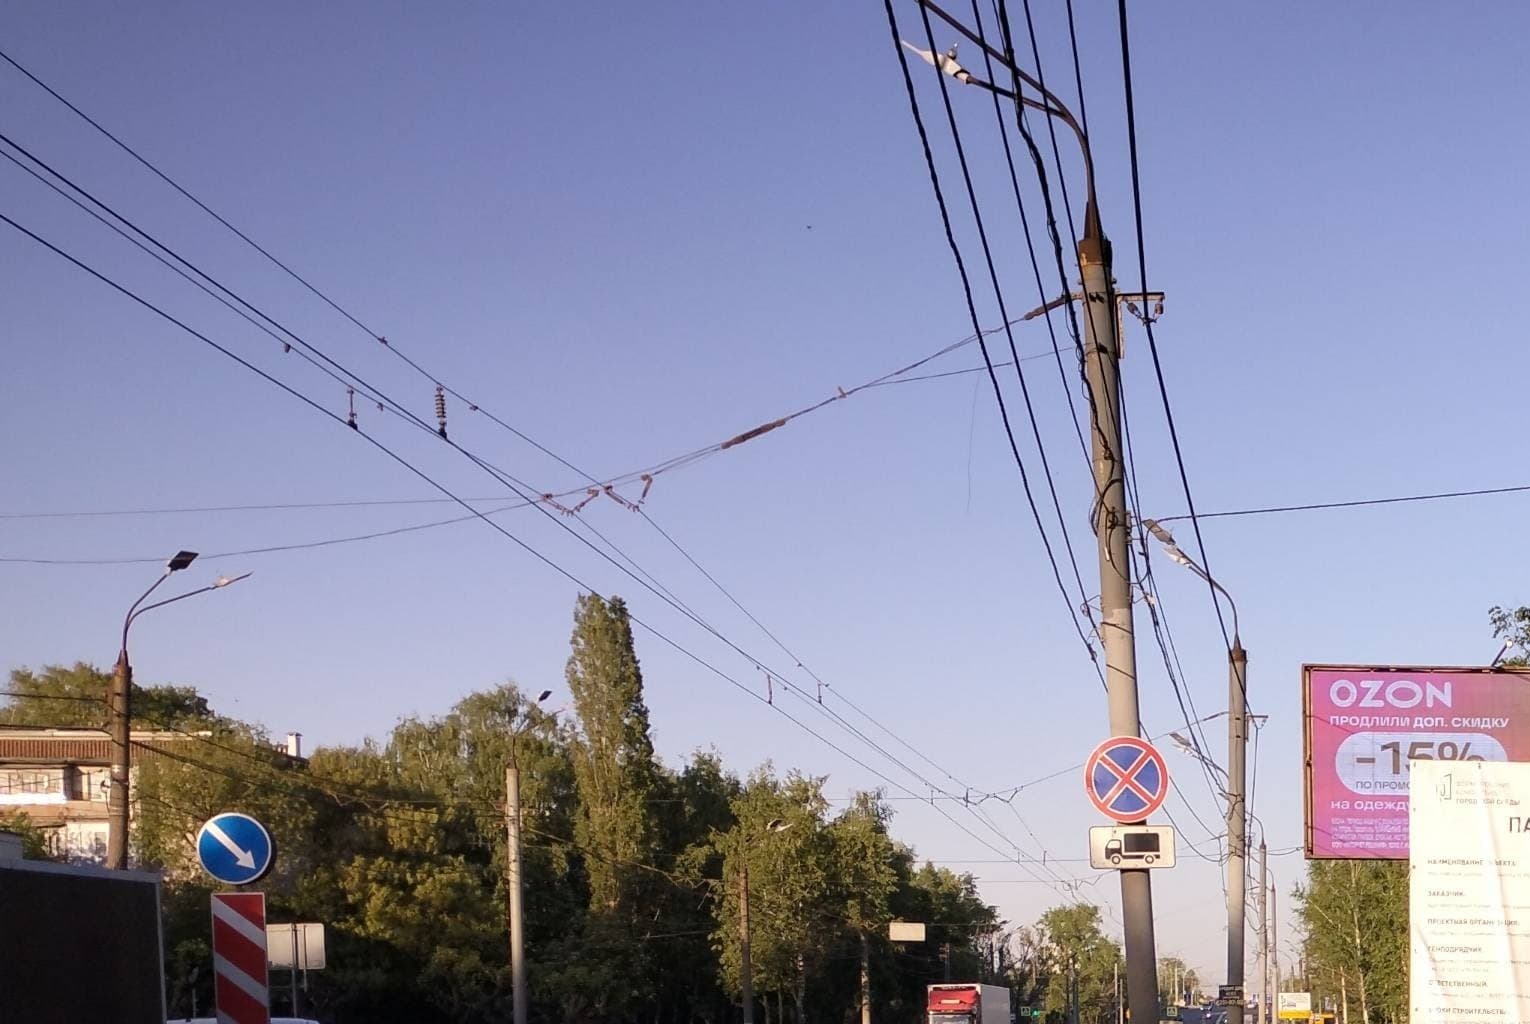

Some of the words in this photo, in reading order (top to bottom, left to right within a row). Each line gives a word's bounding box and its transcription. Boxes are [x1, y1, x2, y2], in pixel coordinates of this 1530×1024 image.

[1329, 679, 1453, 708] OZON
[1329, 715, 1410, 728] ПРОДЛИЛИ
[1413, 716, 1449, 729] ДОП.
[1450, 717, 1510, 729] СКИДКУ
[1355, 781, 1372, 790] ПО
[1374, 781, 1410, 790] ПРОМ
[1330, 801, 1350, 810] на
